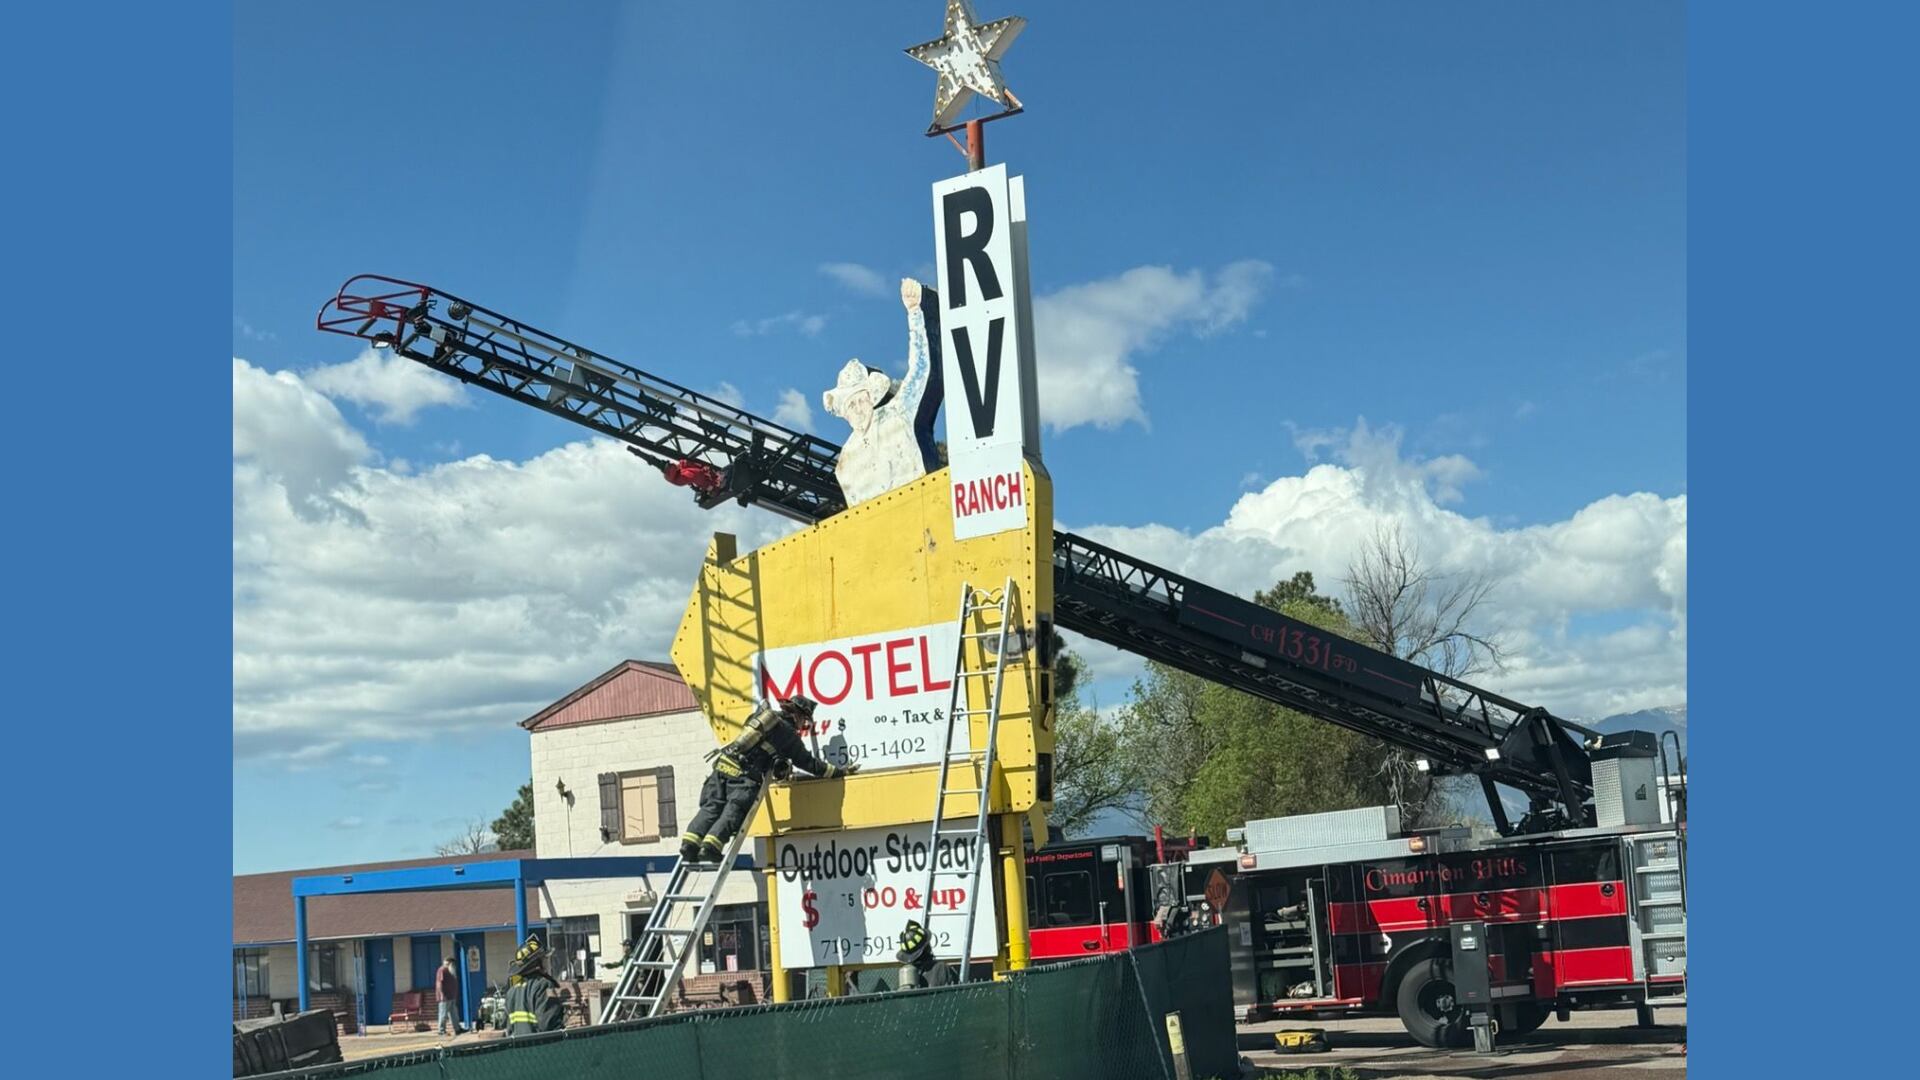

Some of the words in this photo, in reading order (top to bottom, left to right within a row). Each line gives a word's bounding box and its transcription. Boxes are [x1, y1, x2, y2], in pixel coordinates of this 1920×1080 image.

[943, 186, 1005, 439] RV
[954, 471, 1022, 518] RANCH
[761, 635, 951, 705] MOTEL
[1279, 625, 1331, 671] 1331
[838, 717, 846, 732] $
[903, 709, 933, 725] Tax
[934, 707, 945, 720] &
[823, 736, 925, 765] -591-1402
[781, 839, 878, 882] Outdoor
[885, 832, 978, 879] Stoag
[1366, 868, 1464, 891] Cimarron
[1471, 858, 1527, 880] Hills
[802, 889, 819, 931] $
[904, 887, 924, 910] &
[932, 887, 966, 910] up
[821, 931, 951, 959] 719-591-02
